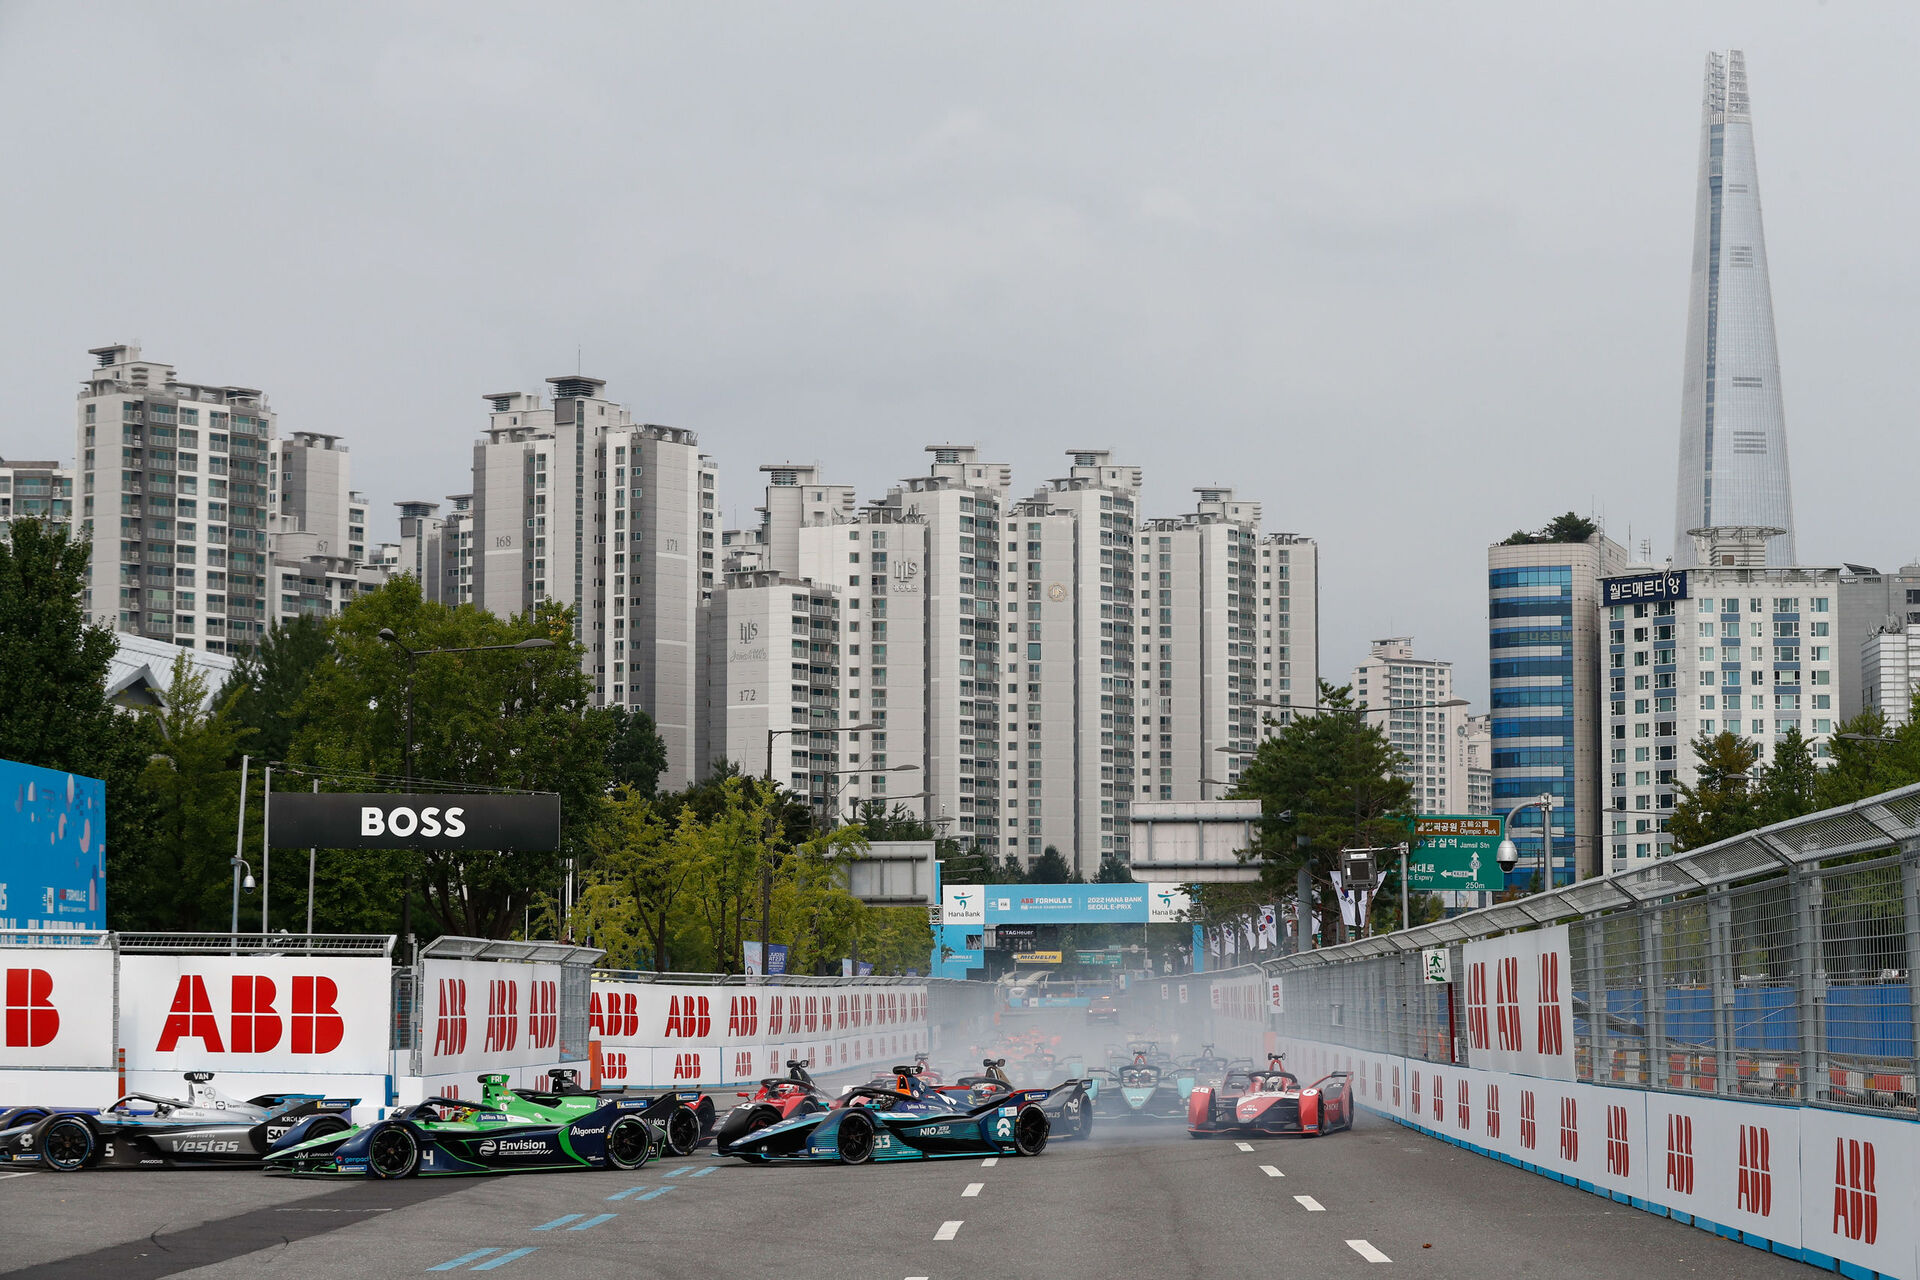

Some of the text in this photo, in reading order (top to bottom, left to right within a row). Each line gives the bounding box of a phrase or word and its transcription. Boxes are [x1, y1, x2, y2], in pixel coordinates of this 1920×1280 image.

[496, 536, 511, 548] 168
[666, 539, 678, 551] 171
[1610, 572, 1680, 600] 월드메르디앙
[739, 689, 756, 702] 172
[361, 806, 466, 838] BOSS
[1459, 828, 1481, 836] Olympic
[1427, 838, 1457, 848] 잠실역
[1272, 984, 1280, 1007] ABB
[156, 975, 344, 1054] ABB
[434, 979, 467, 1056] ABB
[484, 980, 518, 1052] ABB
[528, 980, 556, 1049] ABB
[589, 992, 638, 1036] ABB
[664, 996, 711, 1038] ABB
[728, 996, 758, 1037] ABB
[768, 996, 782, 1035] ABB
[804, 996, 817, 1032] ABB
[194, 1072, 209, 1080] VAN
[674, 1053, 702, 1080] ABB
[735, 1052, 752, 1077] ABB
[1434, 1074, 1444, 1122] ABB
[1458, 1080, 1470, 1130] ABB
[1487, 1084, 1500, 1138] ABB
[571, 1126, 605, 1138] Algorand
[920, 1127, 936, 1136] NIO
[1520, 1090, 1536, 1150] ABB
[1560, 1097, 1578, 1163] ABB
[104, 1143, 114, 1156] 5
[172, 1140, 240, 1152] Vestas
[422, 1150, 434, 1165] 4
[500, 1140, 546, 1150] Envision
[875, 1135, 890, 1148] 33
[1608, 1105, 1630, 1178] ABB
[1667, 1114, 1694, 1195] ABB
[1738, 1124, 1772, 1217] ABB
[1834, 1137, 1878, 1246] ABB
